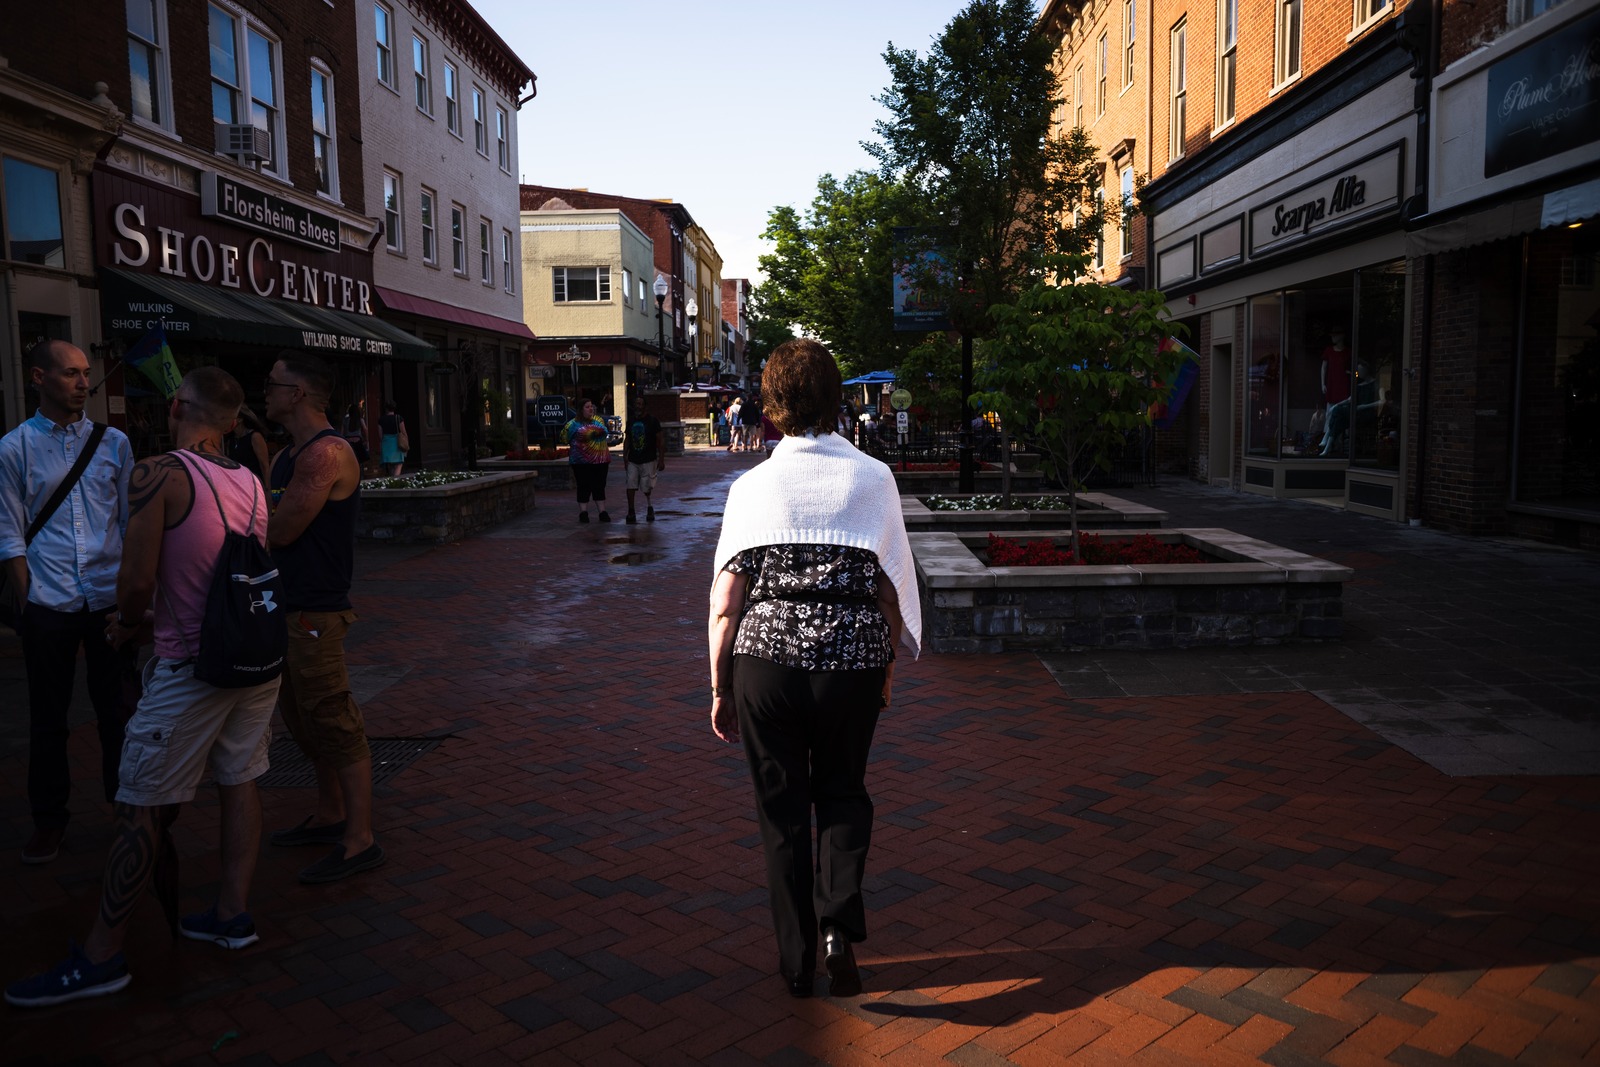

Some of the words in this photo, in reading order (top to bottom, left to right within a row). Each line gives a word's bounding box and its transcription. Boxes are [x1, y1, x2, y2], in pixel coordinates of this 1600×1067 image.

[1499, 76, 1554, 120] Plume
[1531, 113, 1555, 130] VAPE
[1556, 107, 1571, 121] CO
[223, 182, 296, 233] Florsheim
[299, 211, 337, 246] shoes
[1272, 197, 1325, 236] Scarpa
[1328, 175, 1365, 215] Alta
[128, 302, 174, 314] WILKINS
[112, 319, 142, 330] SHOE
[146, 319, 190, 331] CNTER
[302, 331, 337, 349] WILKINS
[340, 335, 361, 351] SHOE
[365, 340, 392, 356] CENTER
[233, 664, 261, 672] UNDER
